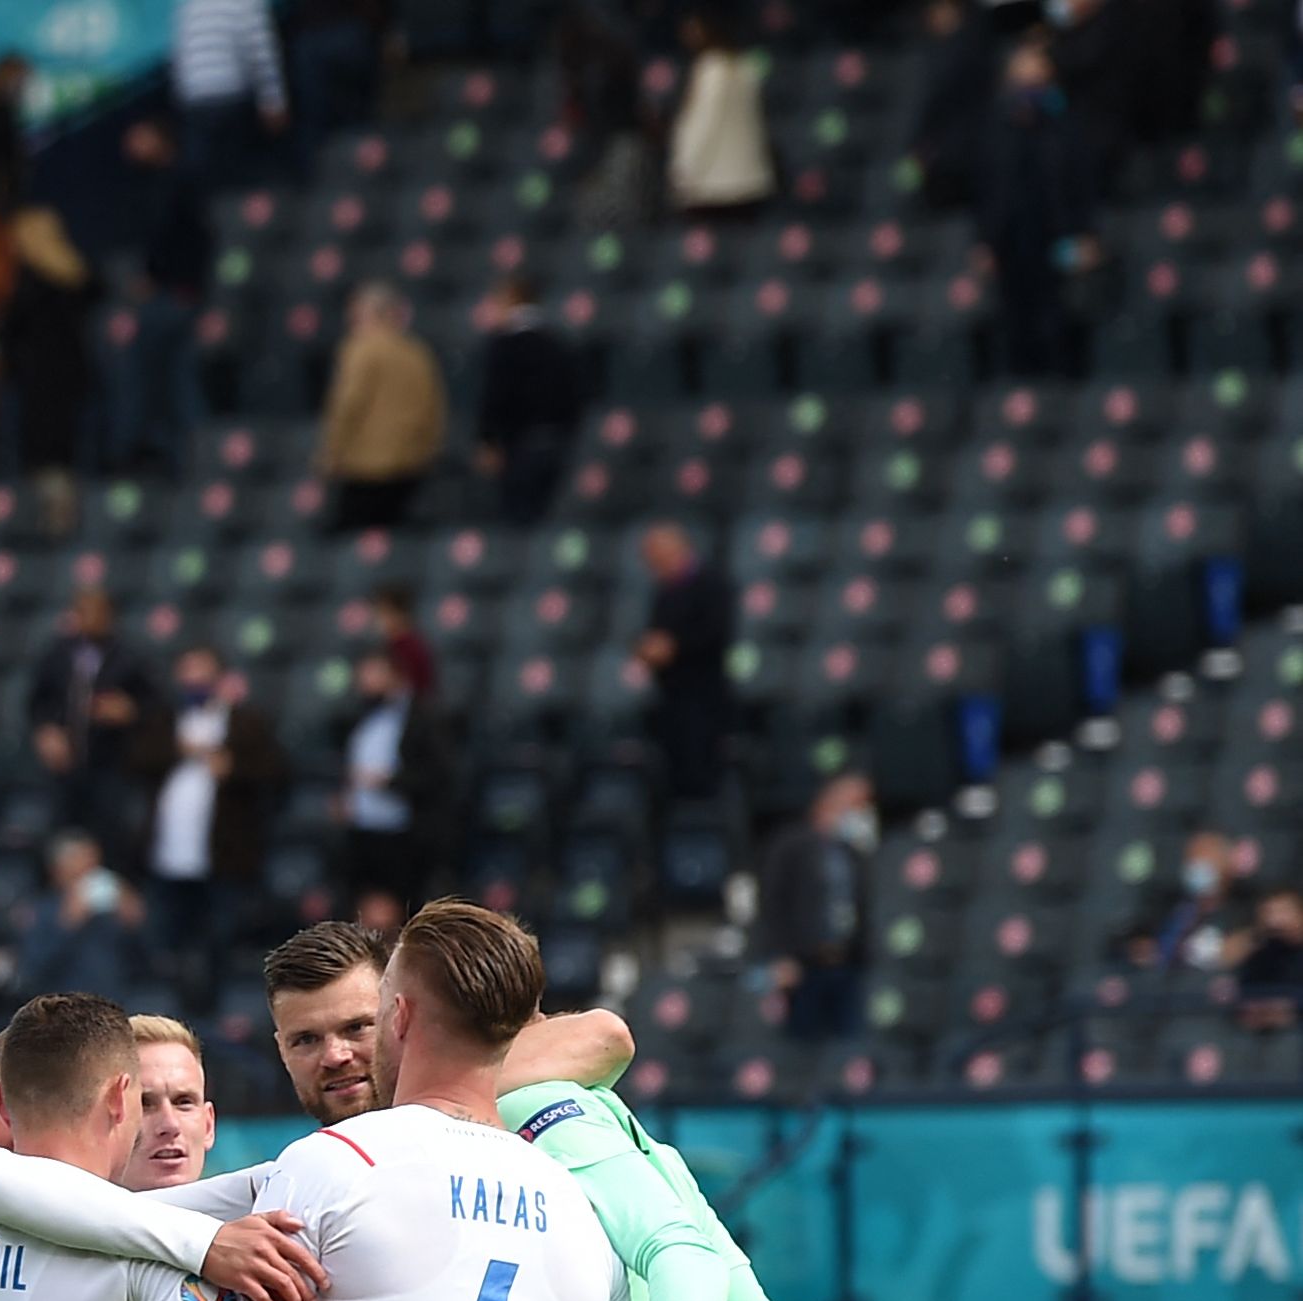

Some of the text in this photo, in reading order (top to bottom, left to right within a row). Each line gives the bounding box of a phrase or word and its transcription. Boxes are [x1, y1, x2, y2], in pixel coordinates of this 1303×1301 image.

[529, 1103, 579, 1132] RESPECT
[450, 1175, 547, 1233] KALAS
[1032, 1182, 1290, 1284] UEFA
